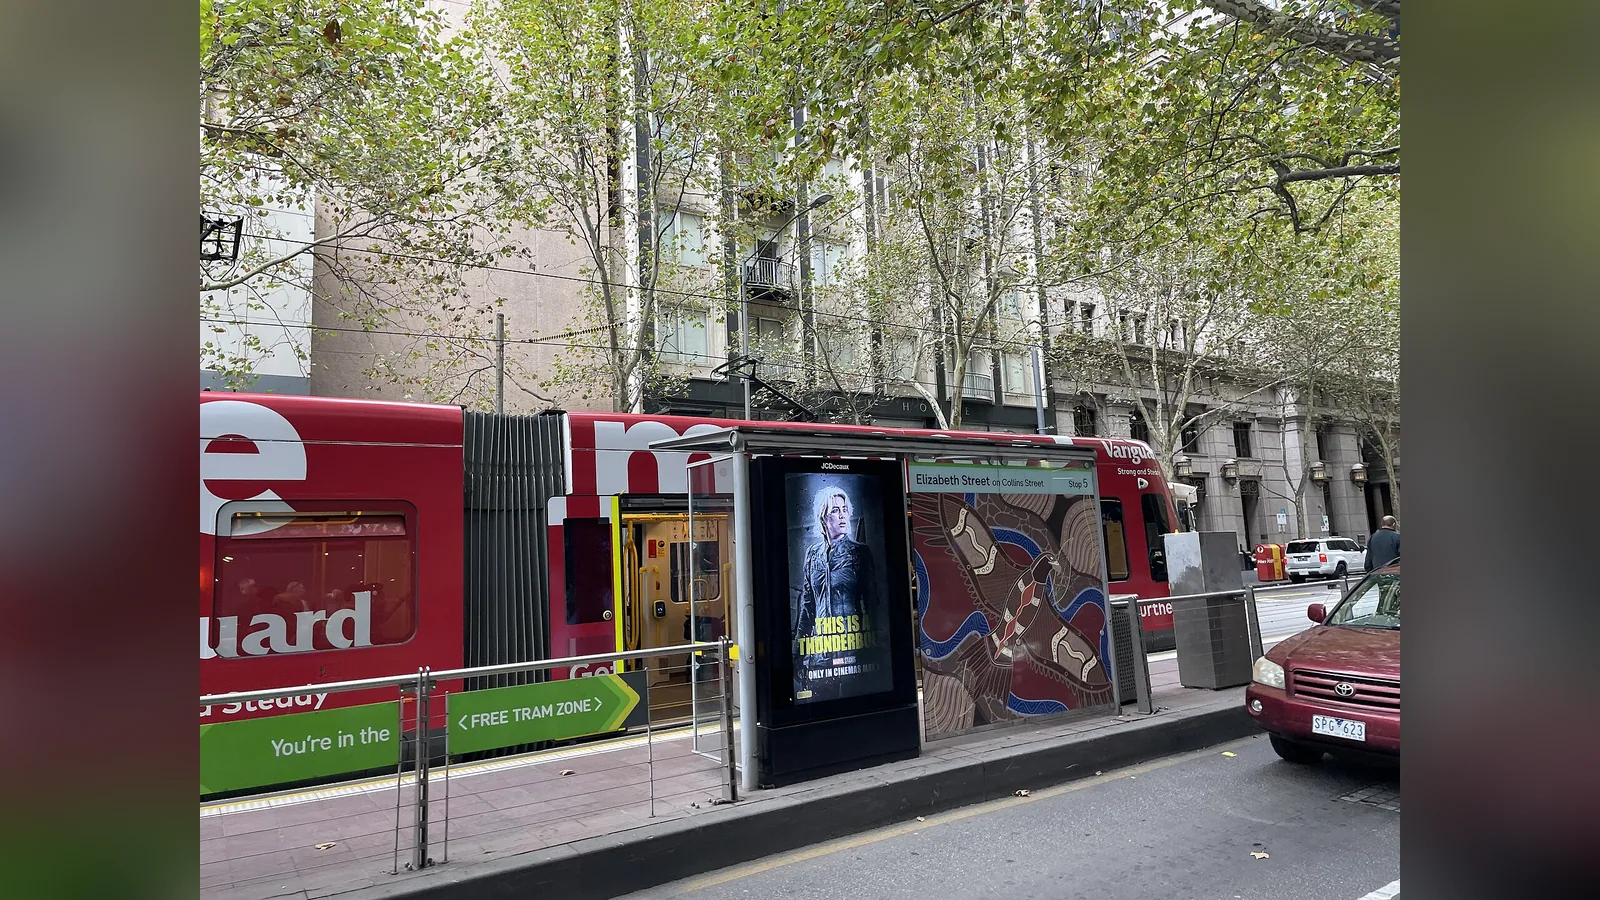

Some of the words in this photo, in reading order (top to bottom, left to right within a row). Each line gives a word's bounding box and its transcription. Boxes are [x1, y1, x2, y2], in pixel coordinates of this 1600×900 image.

[820, 462, 850, 471] JCDecaux
[1117, 467, 1137, 476] Strong
[916, 473, 960, 486] Elizabeth
[961, 475, 990, 487] Street
[1002, 479, 1024, 487] Collins
[1024, 479, 1045, 488] Street
[1068, 480, 1083, 490] Stop
[1083, 478, 1088, 489] 5
[815, 615, 845, 635] THIS
[846, 614, 860, 633] IS
[862, 612, 871, 631] A
[808, 668, 825, 680] ONLY
[825, 667, 833, 678] IN
[833, 664, 862, 677] CINEMAS
[471, 709, 509, 728] FREE
[512, 704, 553, 722] TRAM
[556, 698, 592, 716] ZONE
[1314, 717, 1335, 732] SPG
[1343, 722, 1363, 737] 623
[271, 732, 332, 757] You're
[338, 730, 354, 747] in
[359, 726, 390, 744] the
